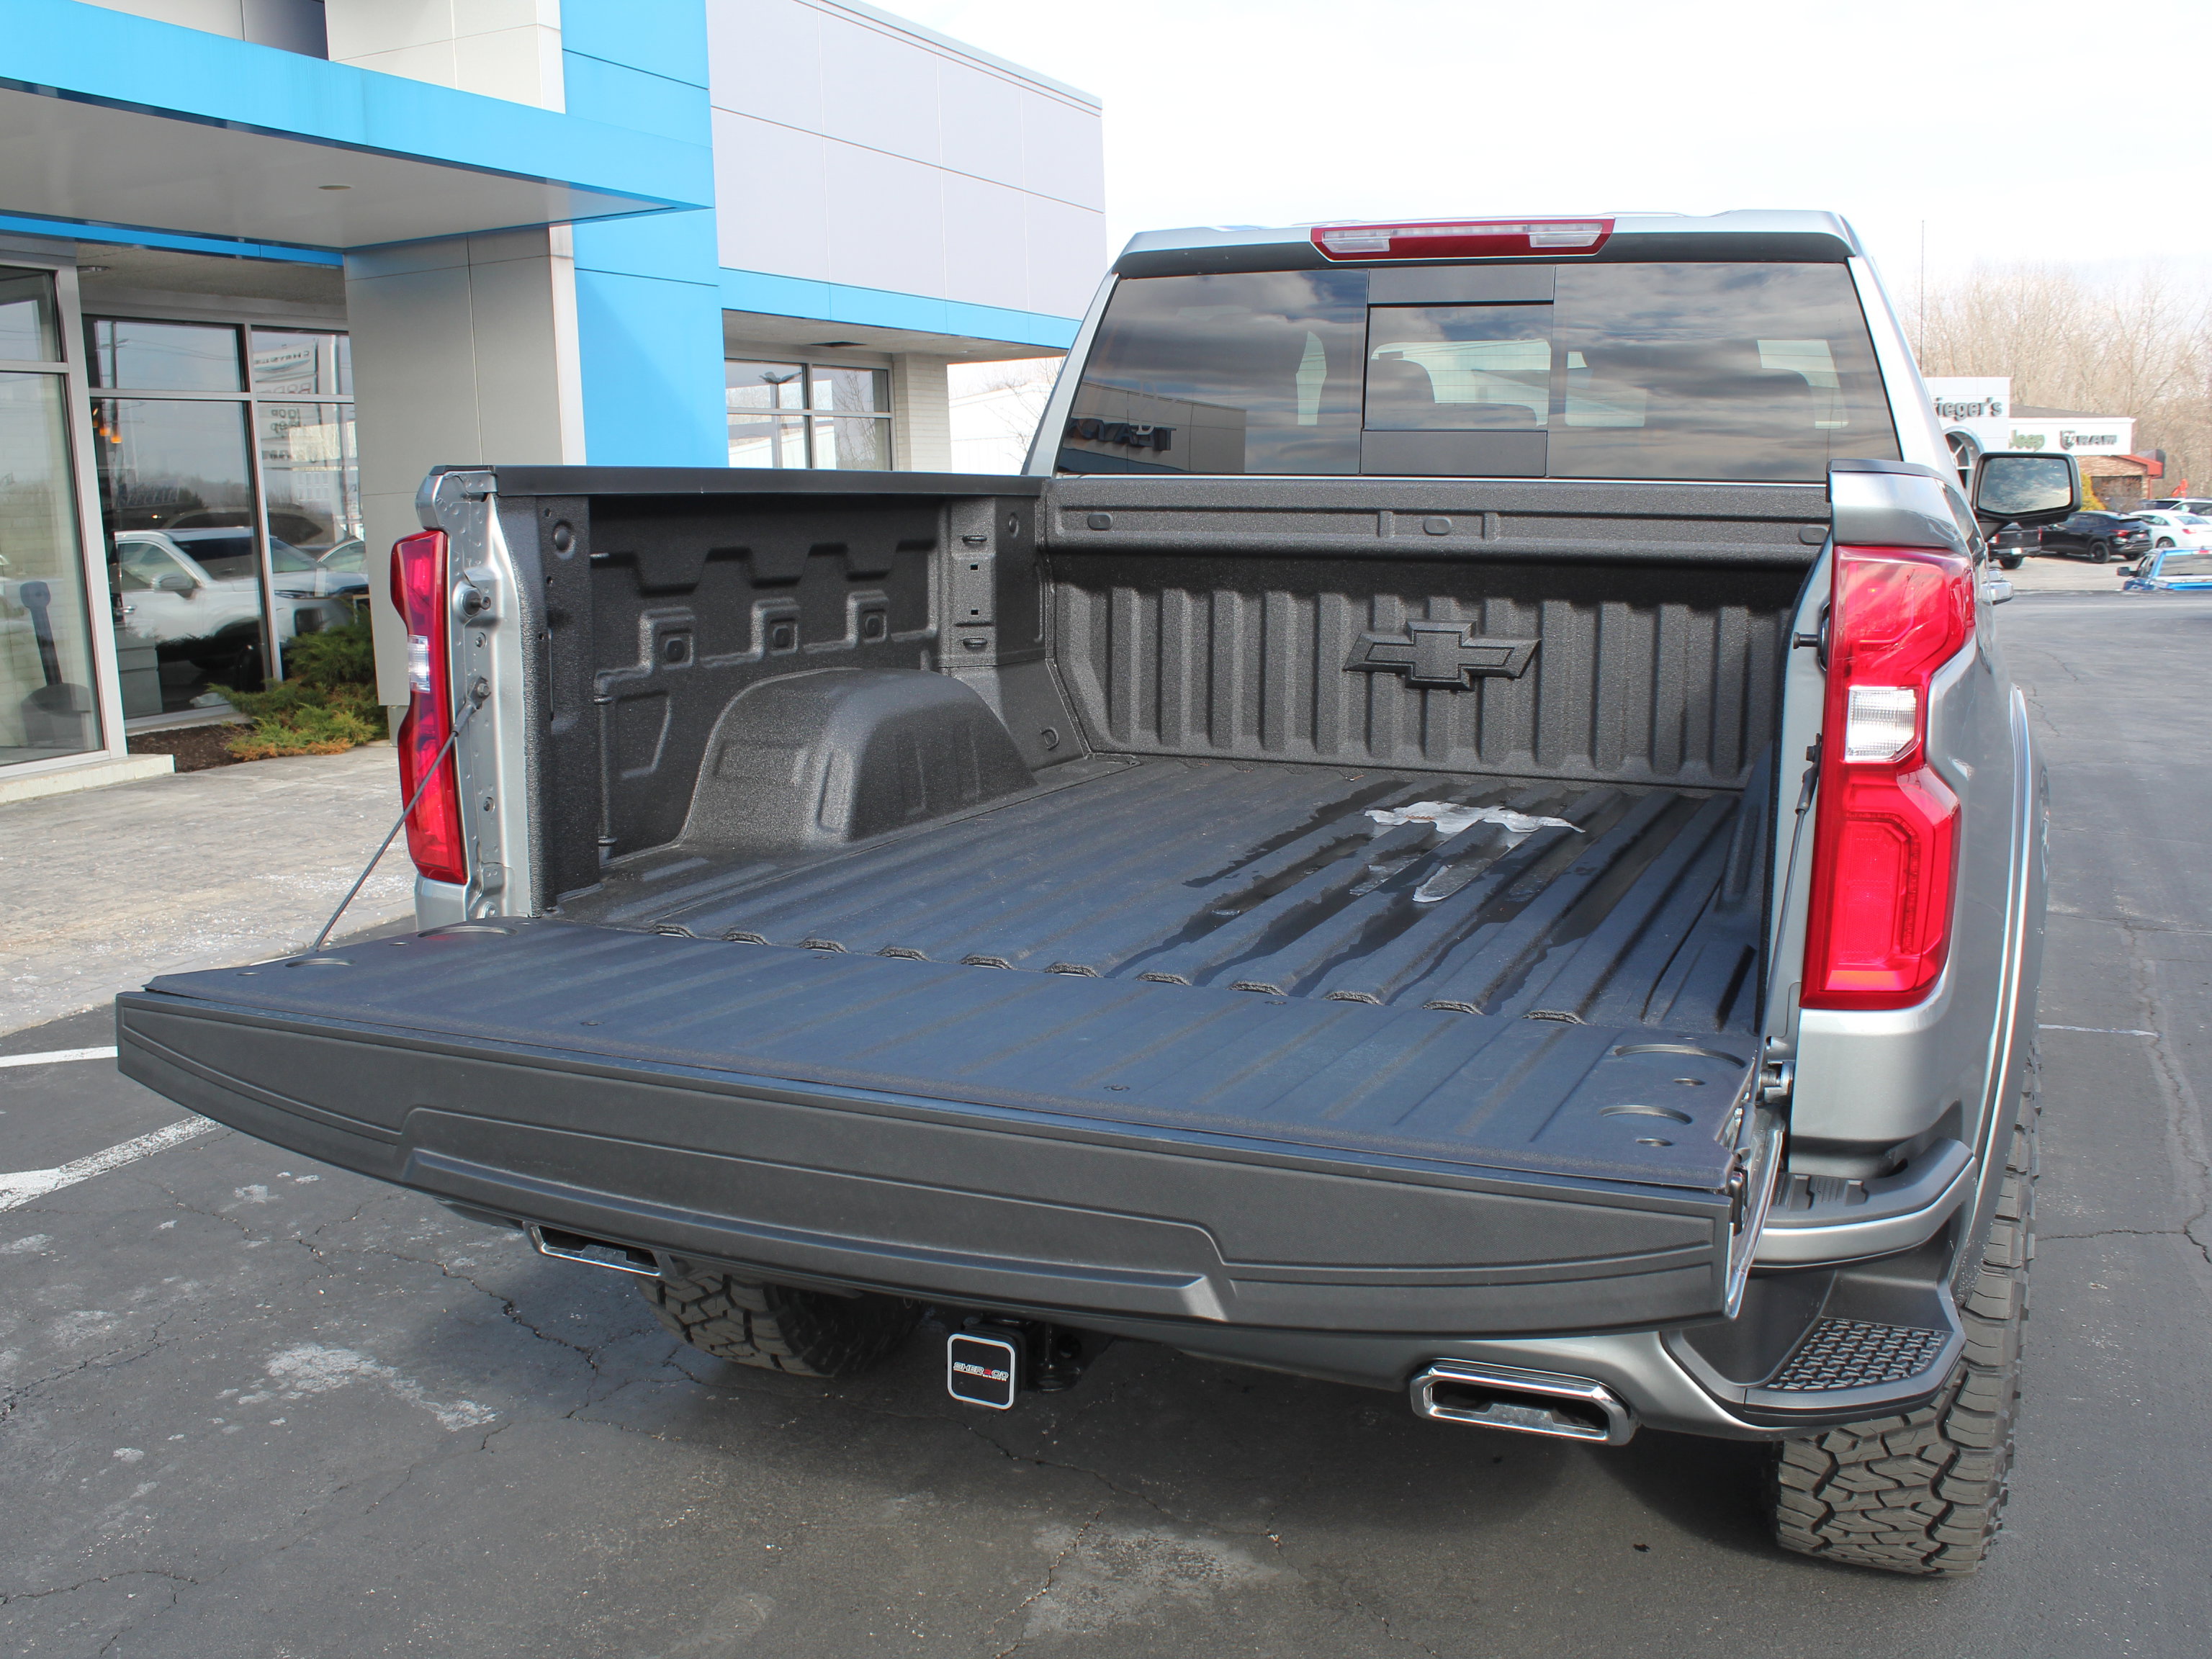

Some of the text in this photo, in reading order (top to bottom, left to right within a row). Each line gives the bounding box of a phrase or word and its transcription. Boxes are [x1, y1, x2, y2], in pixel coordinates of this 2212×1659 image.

[1933, 397, 2002, 421] ieger's
[2008, 430, 2044, 451] Jeep
[2076, 434, 2117, 446] RAM
